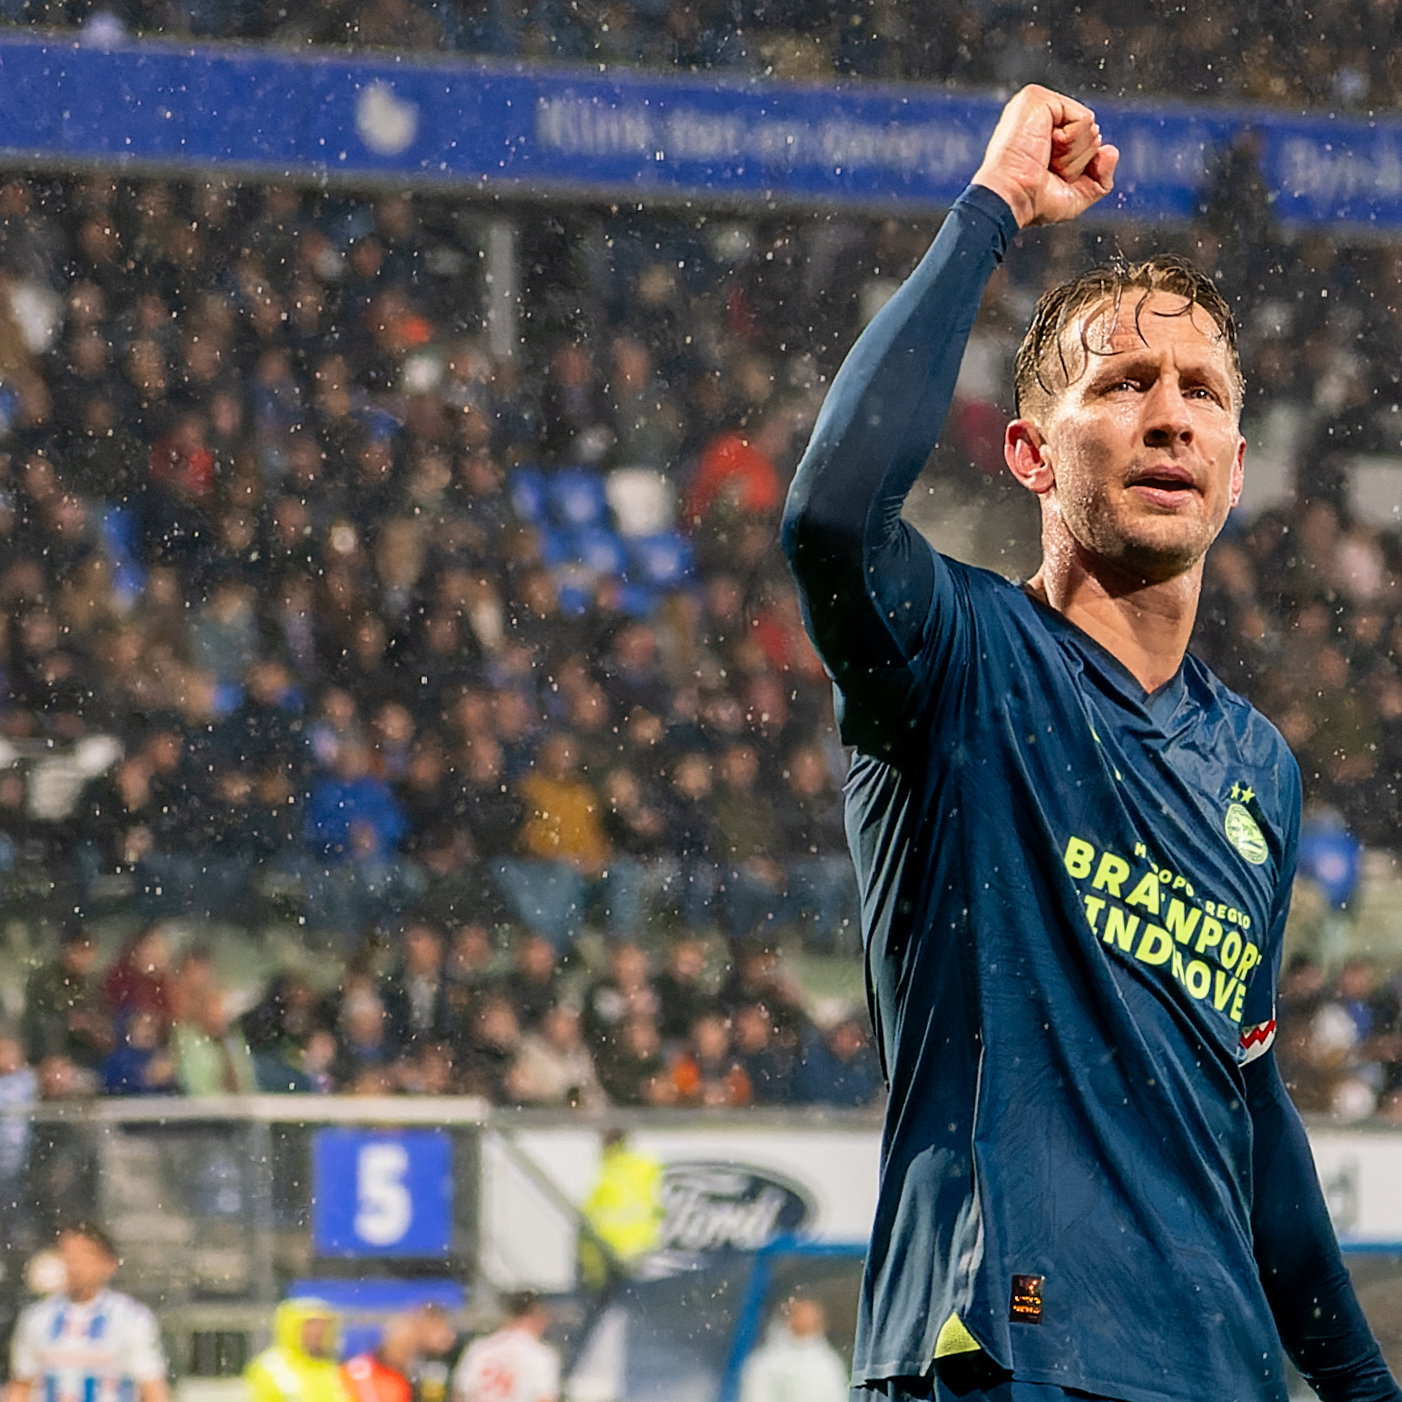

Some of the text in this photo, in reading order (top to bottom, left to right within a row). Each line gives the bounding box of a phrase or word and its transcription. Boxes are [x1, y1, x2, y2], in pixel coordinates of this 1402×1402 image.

[1063, 836, 1263, 982] BRANPOR
[1076, 889, 1247, 1023] INDHOVE
[353, 1142, 413, 1247] 5
